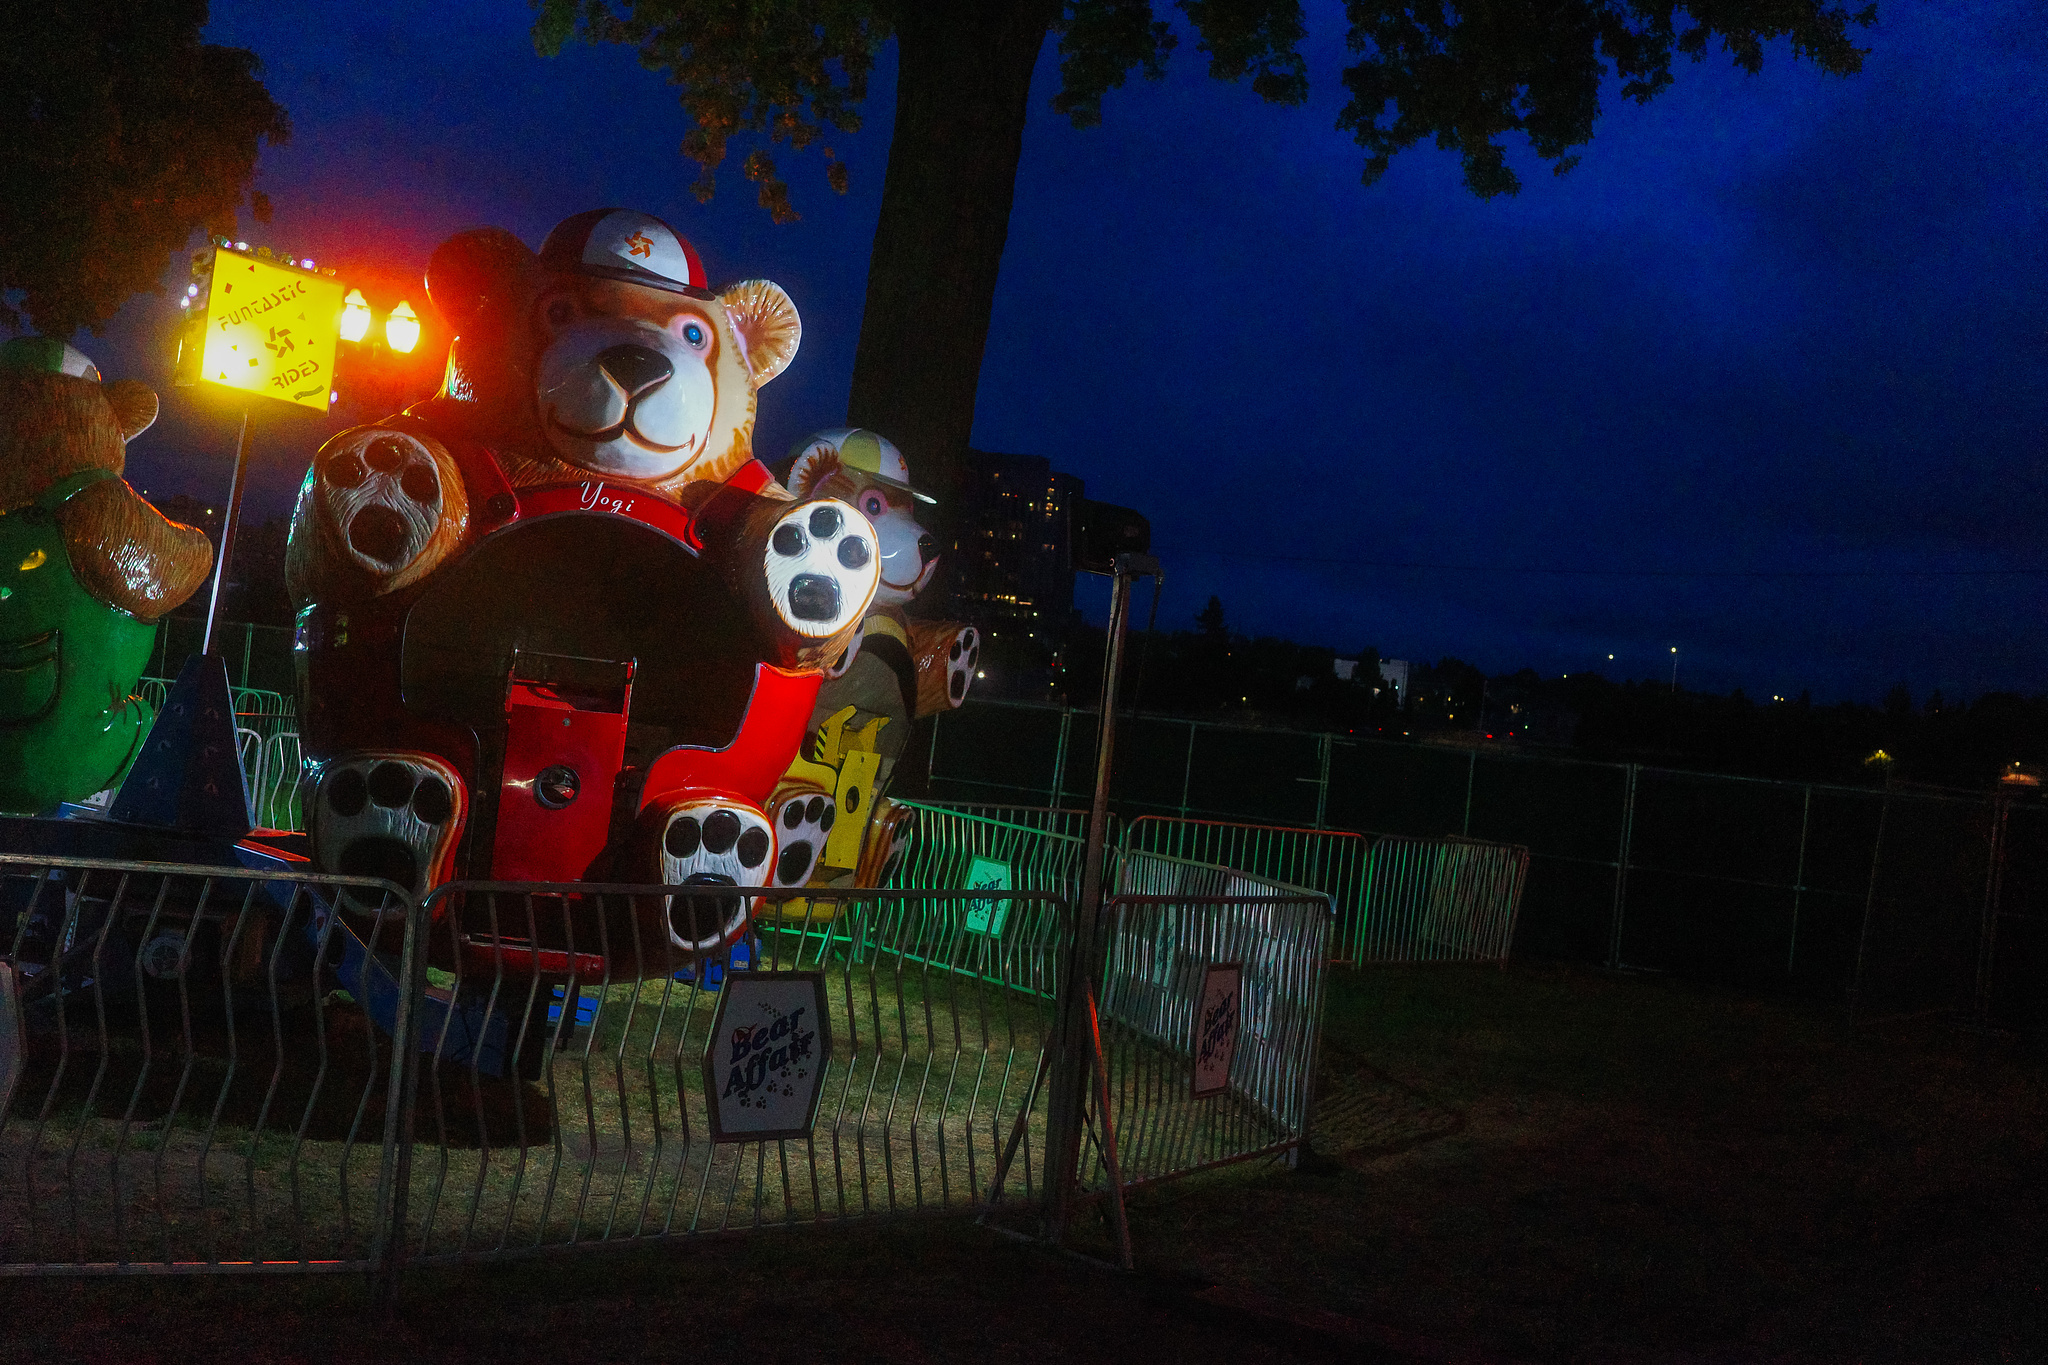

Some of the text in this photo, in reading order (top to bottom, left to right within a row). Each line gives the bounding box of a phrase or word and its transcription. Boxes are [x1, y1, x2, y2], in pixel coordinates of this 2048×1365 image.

[218, 281, 306, 331] FUNTASTIC
[272, 360, 320, 389] RIDES
[580, 481, 635, 513] Yogi
[730, 1007, 805, 1065] Bear
[1198, 1009, 1236, 1064] Affair
[1203, 991, 1234, 1037] Bear
[722, 1031, 815, 1100] Affair
